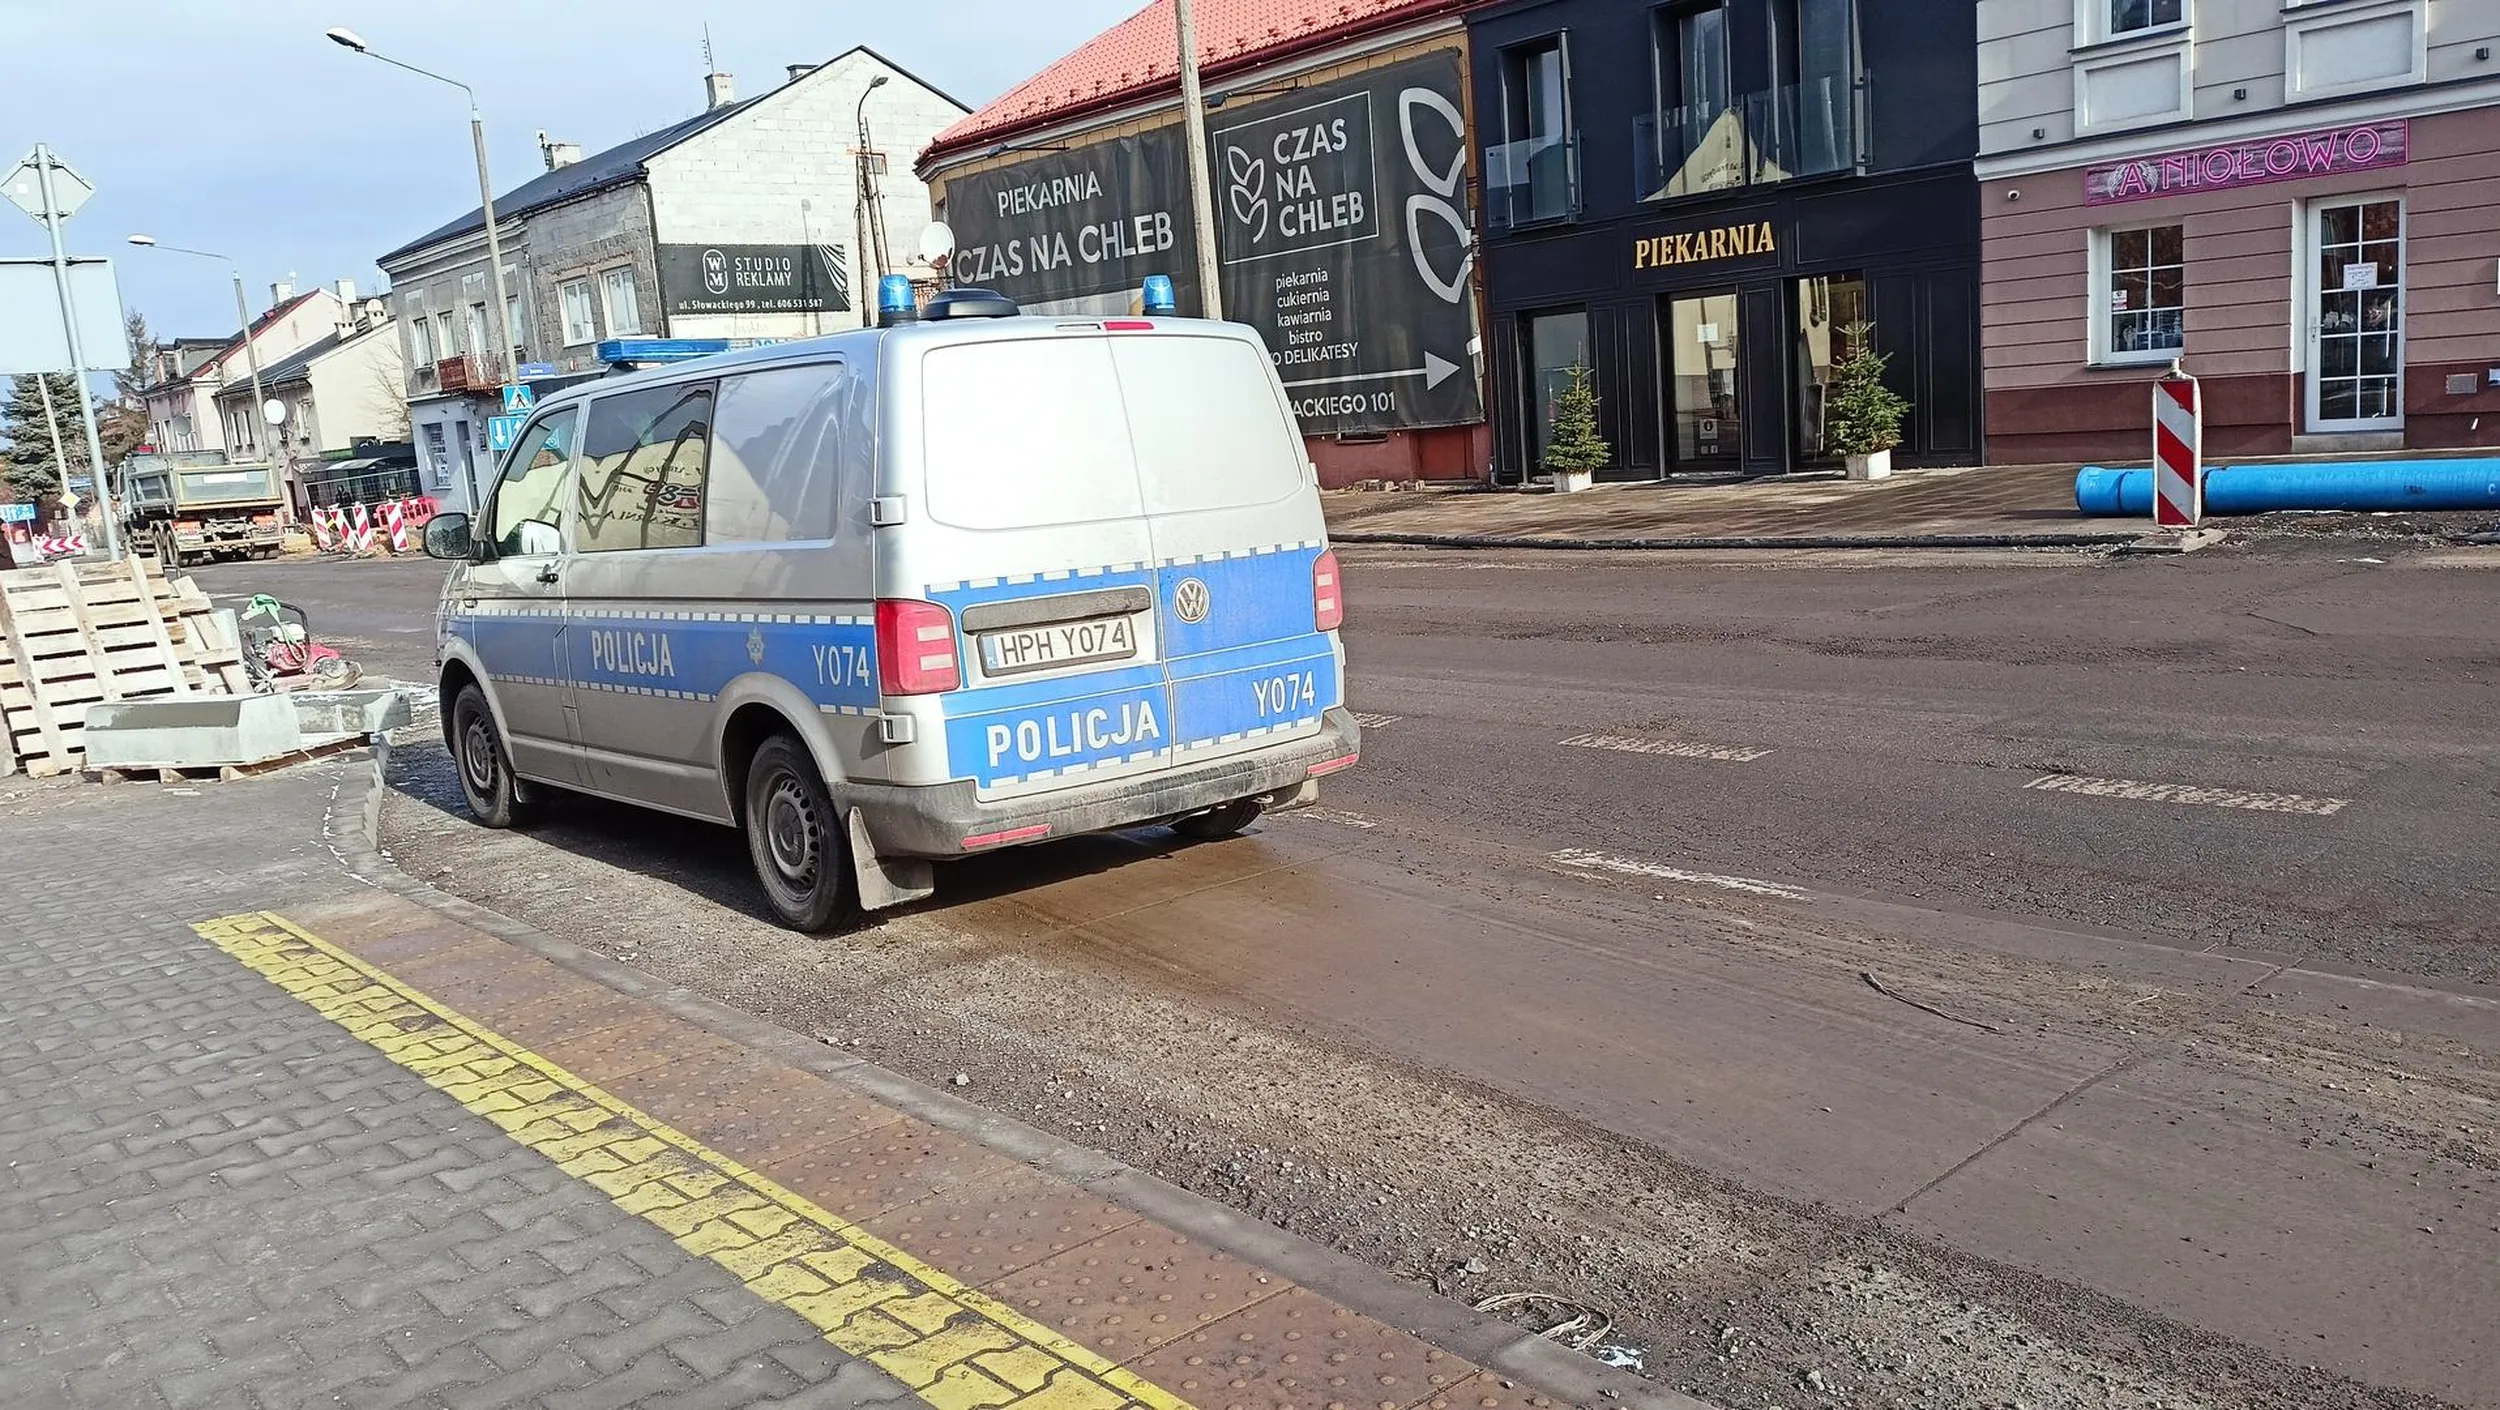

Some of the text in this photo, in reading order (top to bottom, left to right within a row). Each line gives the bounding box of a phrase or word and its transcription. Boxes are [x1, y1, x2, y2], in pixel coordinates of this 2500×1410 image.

[1273, 118, 1347, 165] CZAS
[997, 170, 1103, 218] PIEKARNIA
[1276, 165, 1317, 202] NA
[1279, 191, 1364, 237] CHLEB
[735, 257, 791, 272] STUDIO
[956, 211, 1174, 285] CZAS NA CHLEB
[1634, 221, 1776, 270] PIEKARNIA
[736, 272, 792, 287] REKLAMY
[1275, 267, 1328, 293] piekarnia
[1277, 287, 1330, 309] cukiernia
[777, 299, 792, 308] 606
[1277, 307, 1332, 328] kawiarnia
[1284, 342, 1359, 366] DELIKATESY
[1289, 329, 1323, 346] bistro
[1371, 391, 1396, 413] 101
[591, 630, 676, 677] POLICJA
[999, 622, 1127, 666] HPH Y074
[812, 644, 870, 687] Y074
[1253, 671, 1316, 718] Y074
[986, 700, 1161, 768] POLICJA
